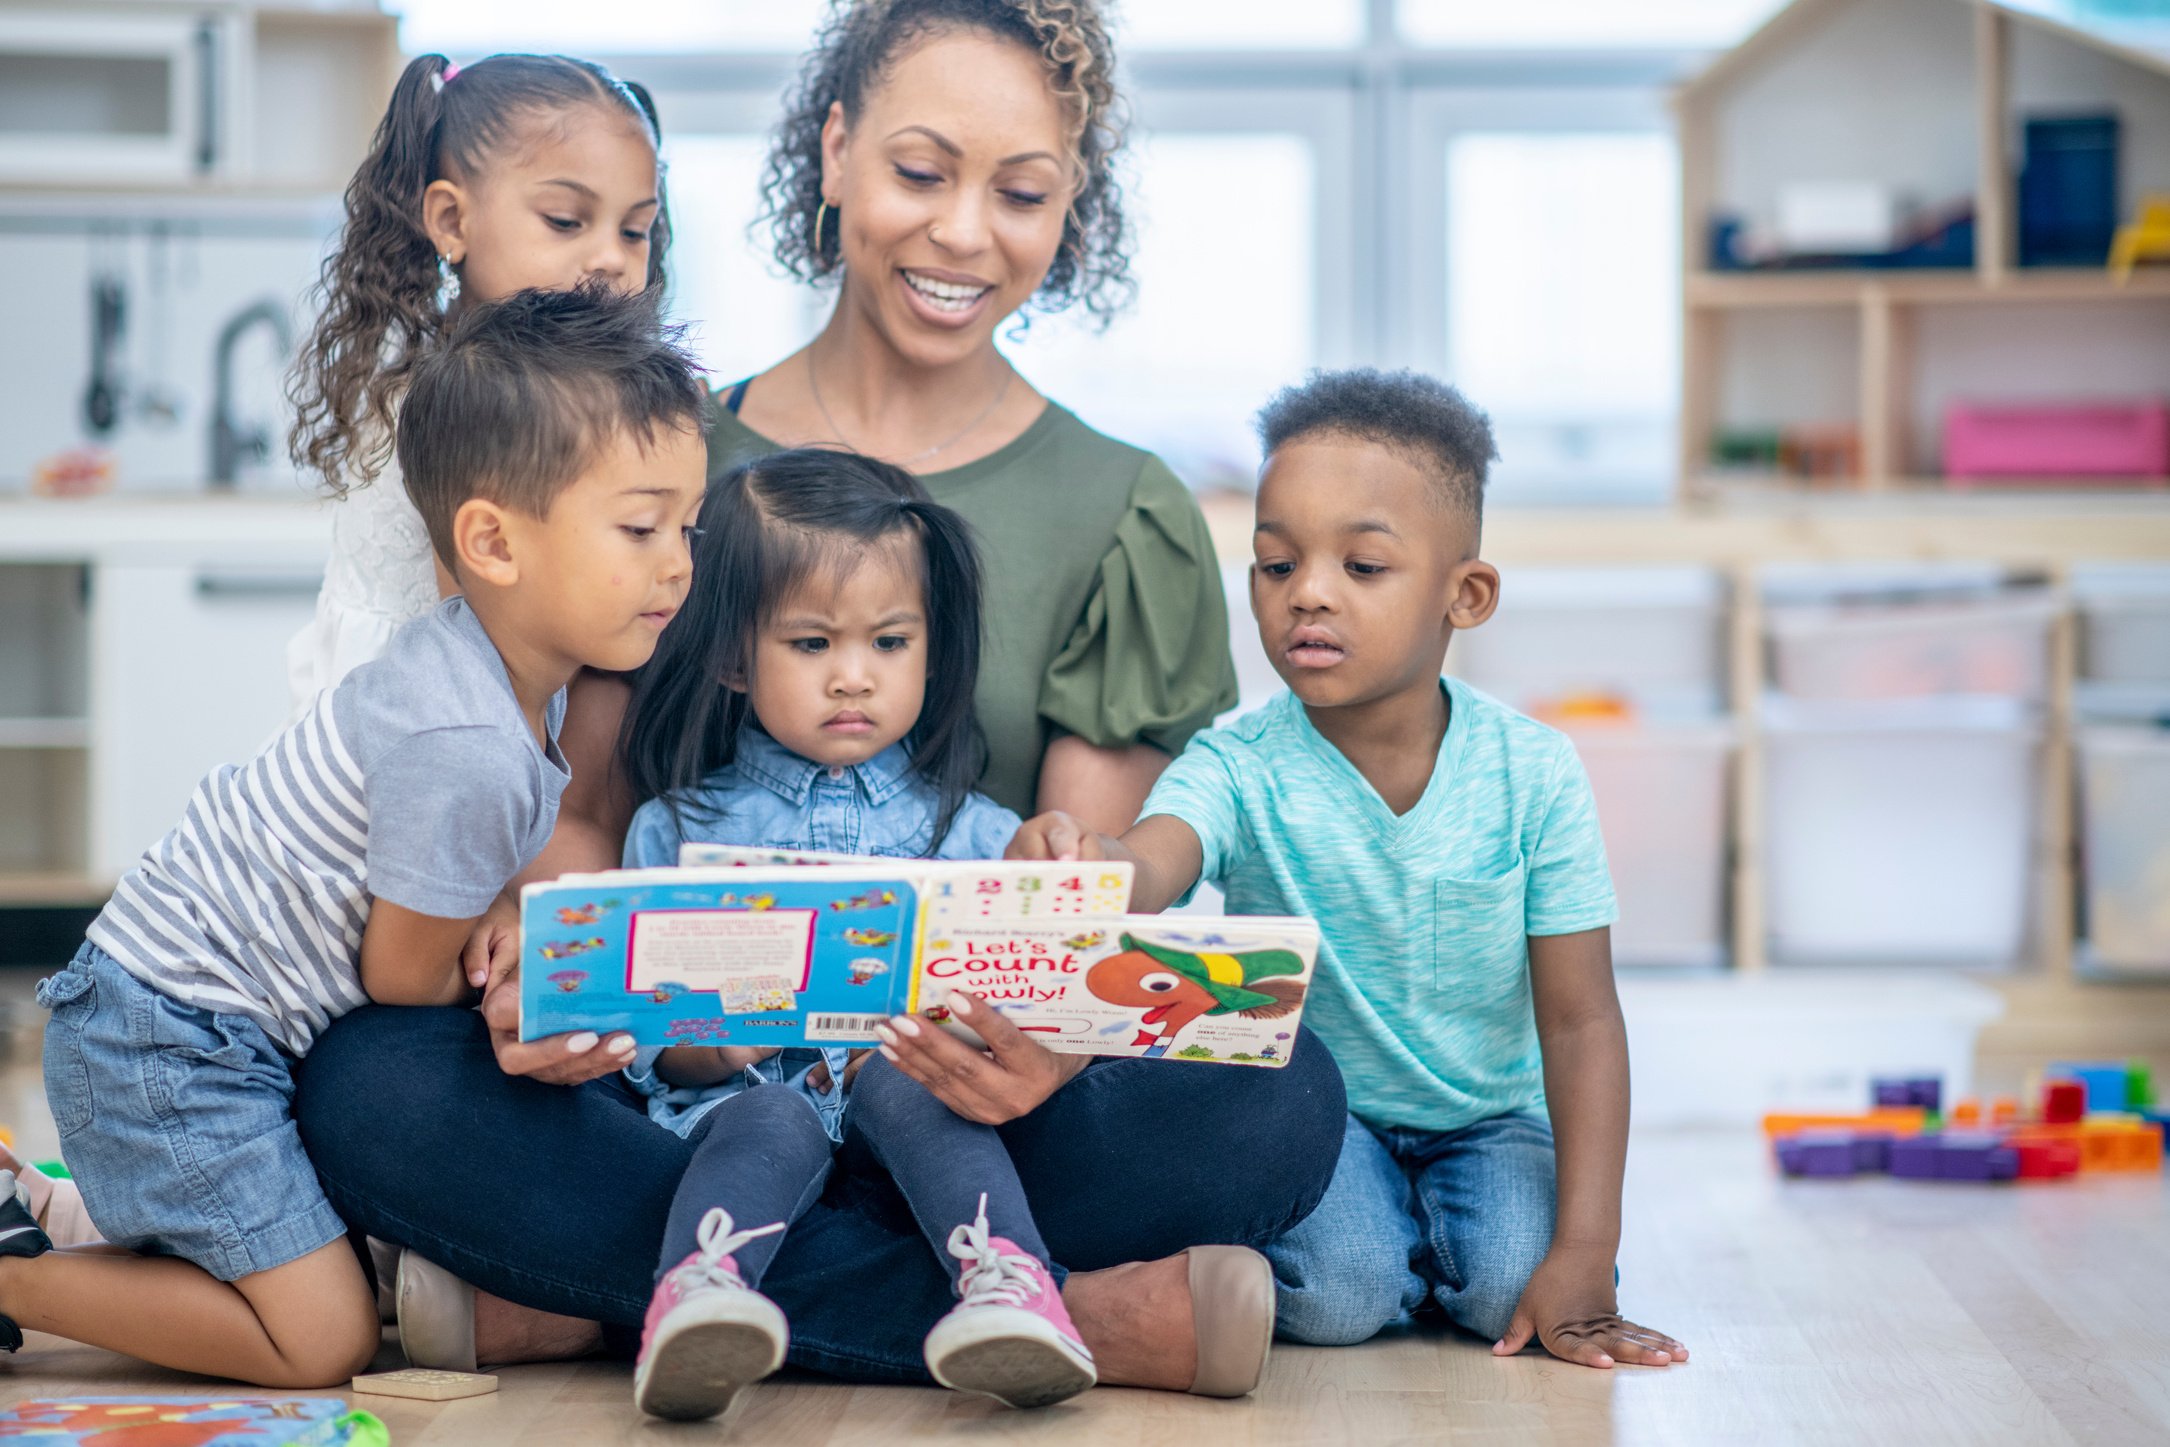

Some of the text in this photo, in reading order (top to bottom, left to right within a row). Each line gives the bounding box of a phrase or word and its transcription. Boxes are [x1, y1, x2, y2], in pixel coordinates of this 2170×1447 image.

[939, 873, 1123, 897] 1 2 3 4 5
[967, 938, 1047, 955] Let's
[926, 954, 1079, 977] Count
[969, 974, 1028, 986] with
[951, 985, 1066, 1002] owly!
